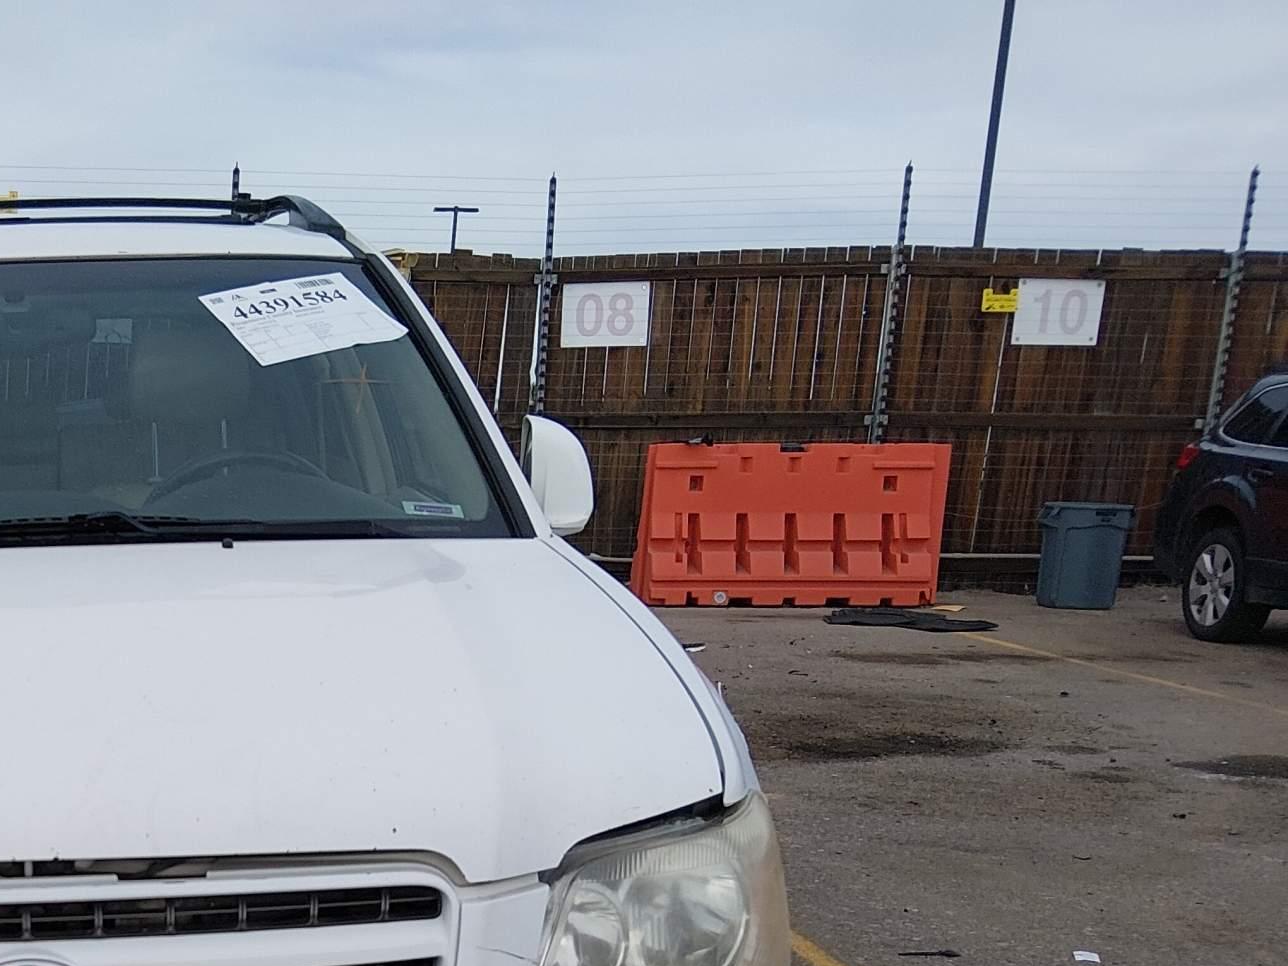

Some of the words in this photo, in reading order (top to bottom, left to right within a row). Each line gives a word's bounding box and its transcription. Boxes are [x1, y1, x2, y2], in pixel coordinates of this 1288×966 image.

[233, 289, 348, 319] 44391584
[575, 292, 634, 337] 08
[1033, 289, 1089, 335] 10
